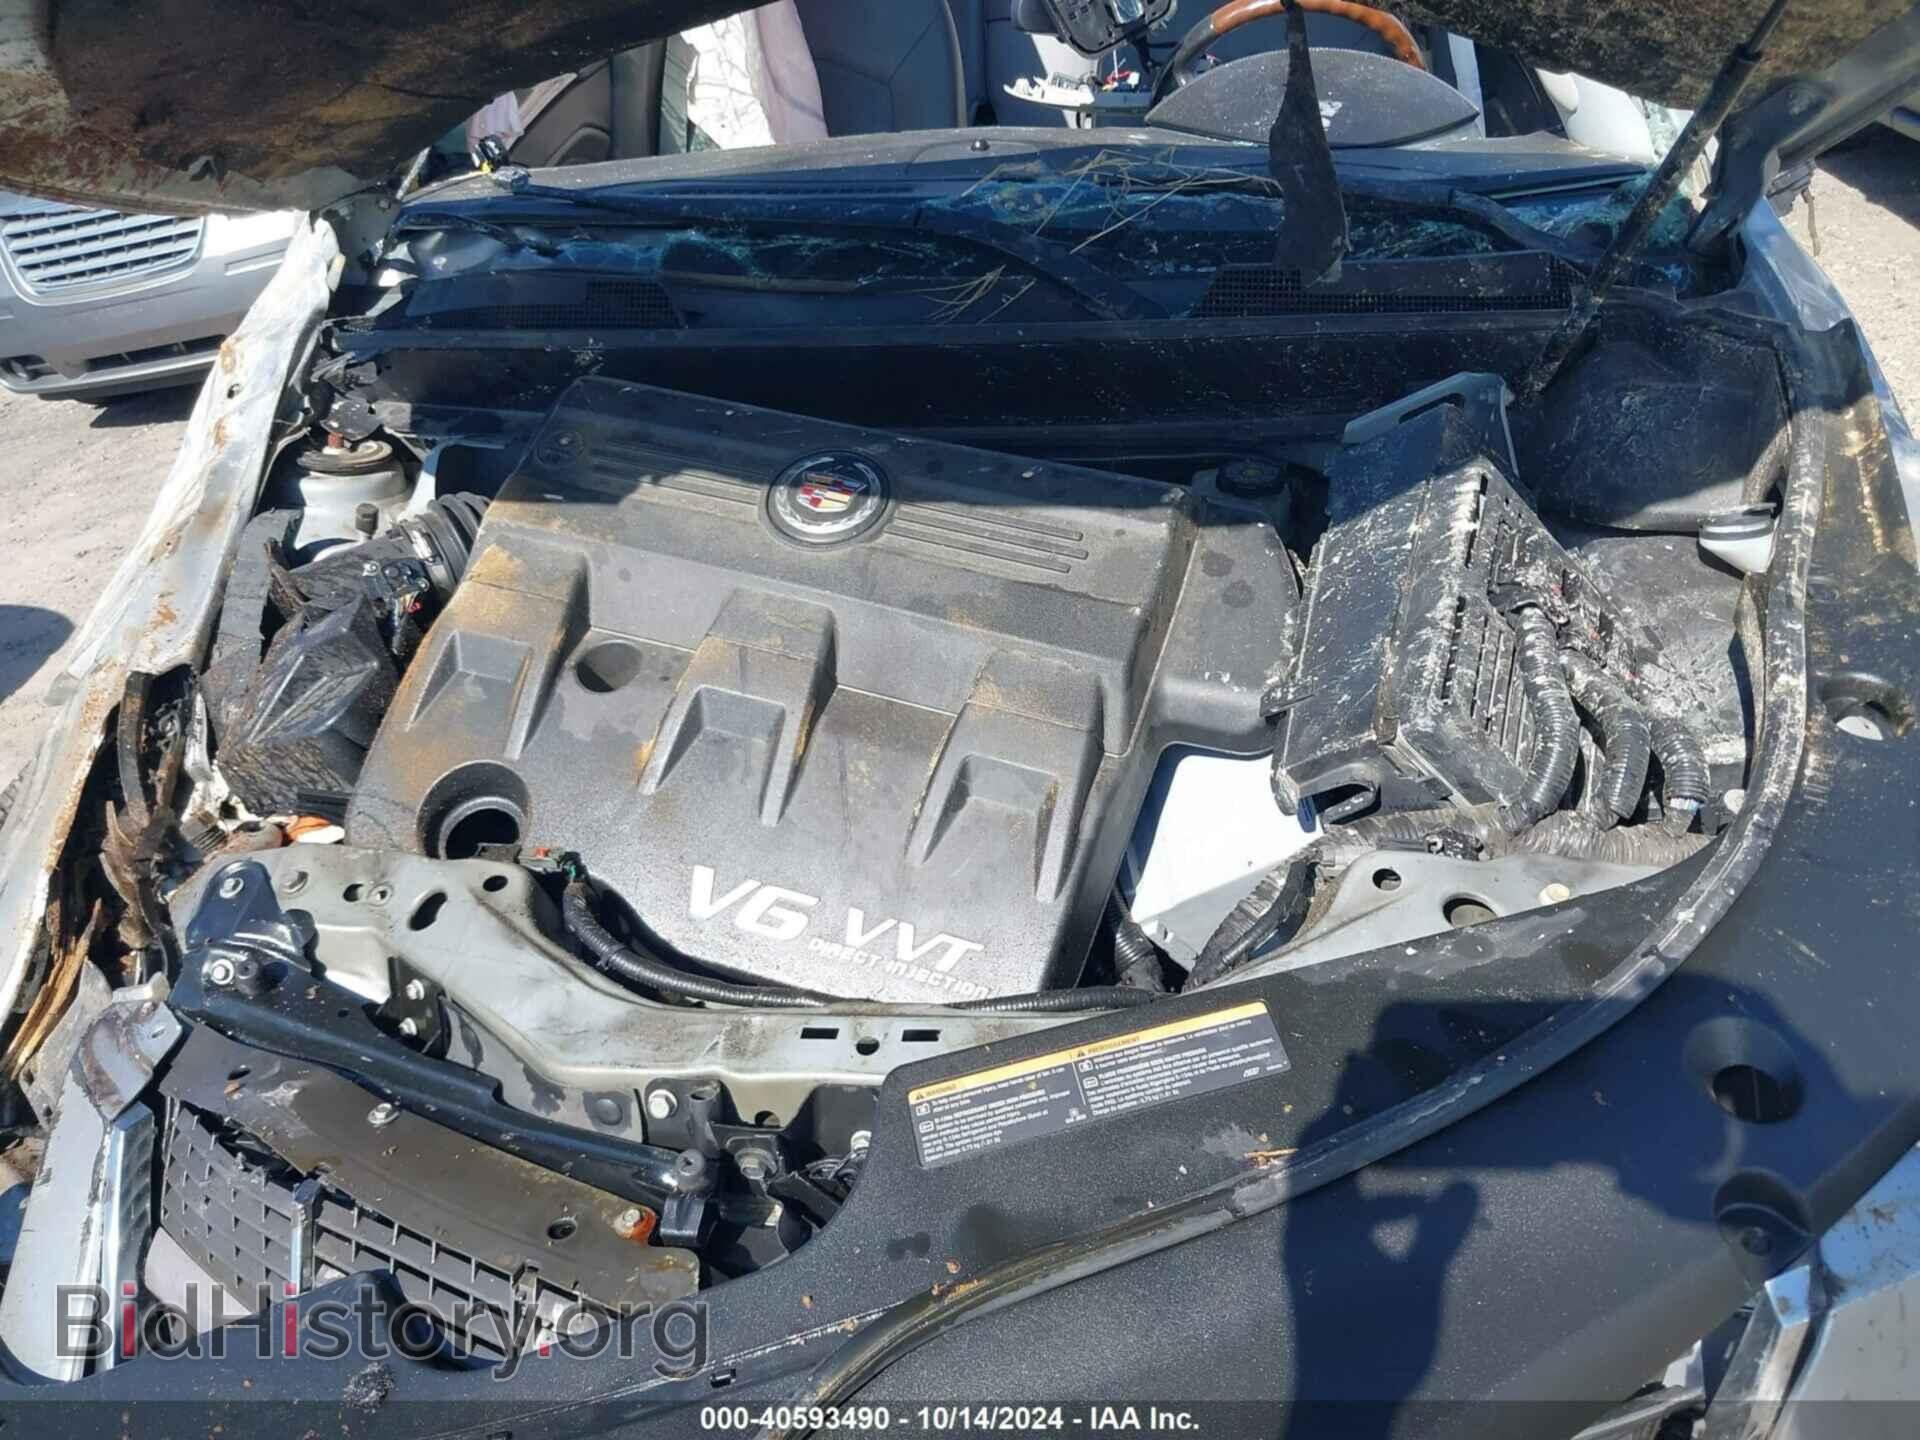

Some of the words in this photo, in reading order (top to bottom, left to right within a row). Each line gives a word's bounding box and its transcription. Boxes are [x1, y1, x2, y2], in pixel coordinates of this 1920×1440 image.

[689, 865, 820, 939] V6
[846, 907, 985, 973] VVT
[809, 937, 881, 966] DIRECT
